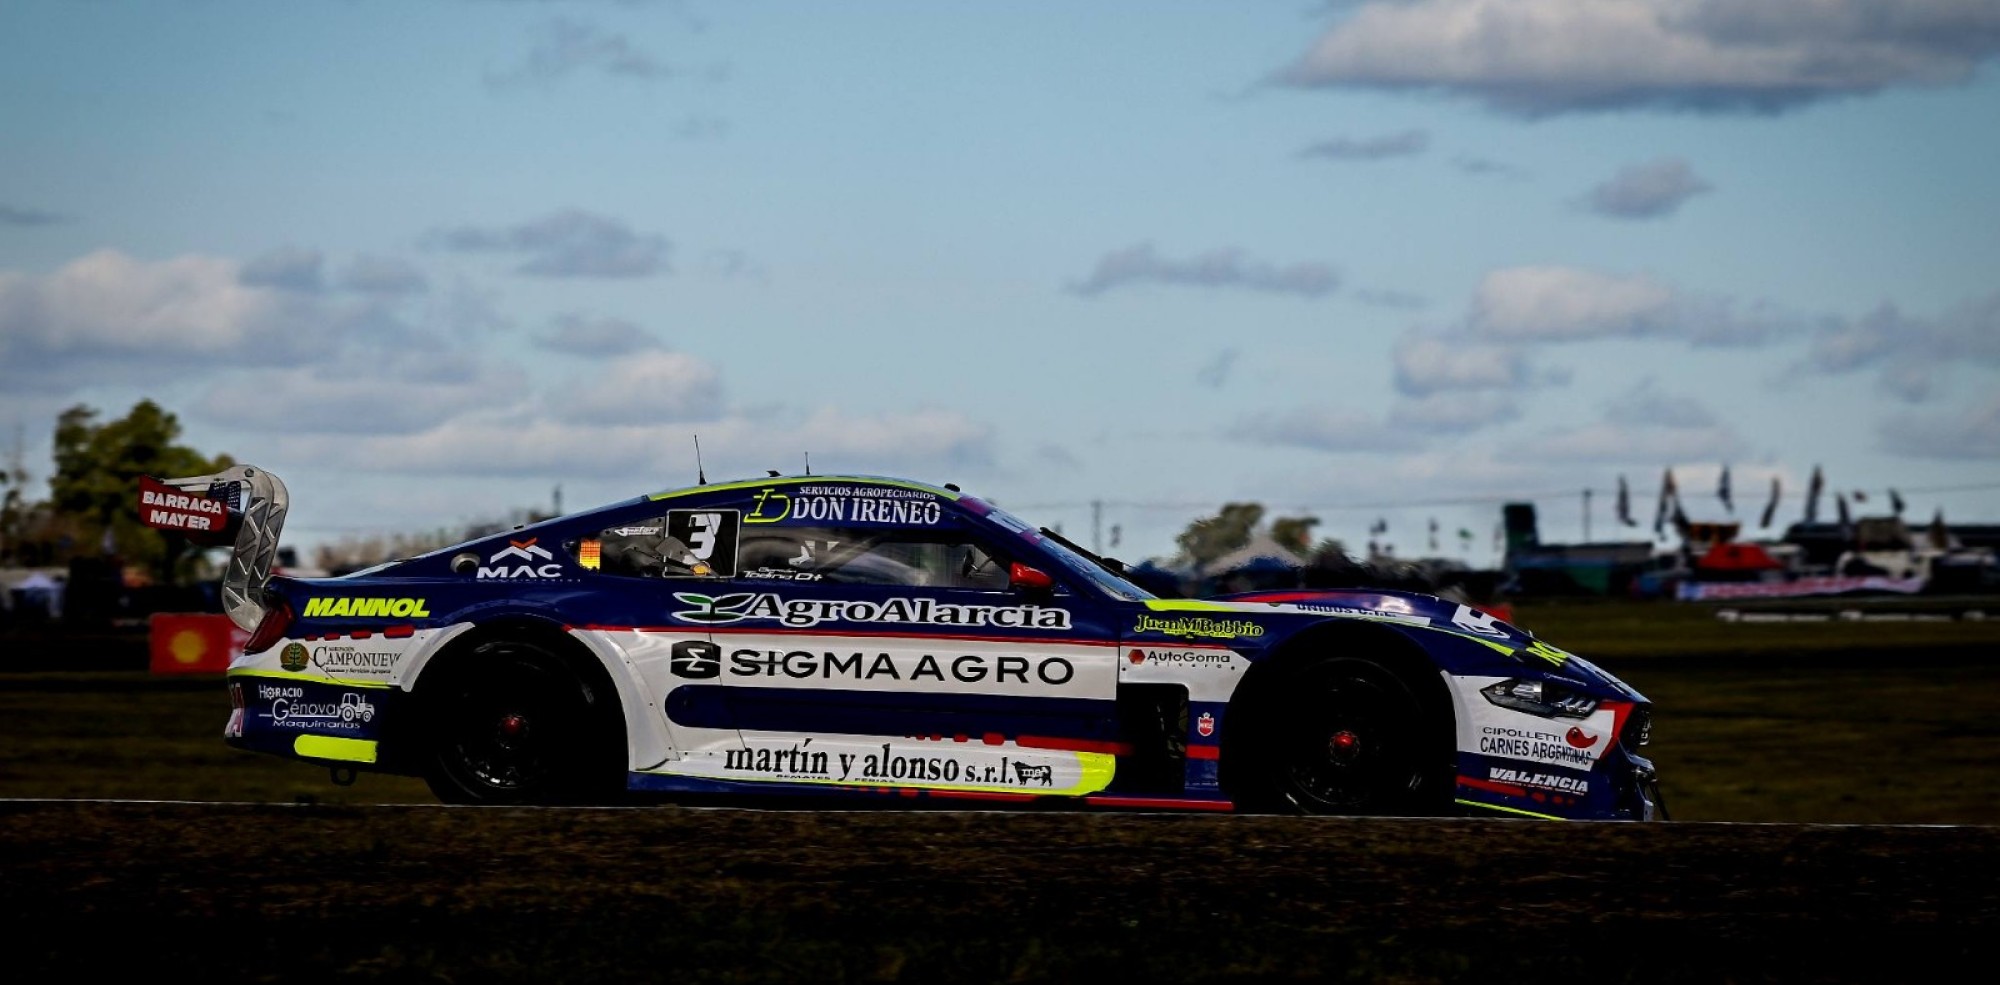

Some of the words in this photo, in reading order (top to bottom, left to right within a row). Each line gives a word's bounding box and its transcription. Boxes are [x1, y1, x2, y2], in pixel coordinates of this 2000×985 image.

[142, 491, 222, 514] BARRACA
[800, 486, 851, 496] SERVICIOS
[853, 488, 936, 500] AGROPECUARIOS
[150, 510, 211, 530] MAYER
[792, 497, 845, 520] DON
[849, 498, 941, 525] IRENEO
[688, 513, 721, 560] 3
[476, 564, 563, 578] MAC
[303, 598, 430, 617] MANNOL
[745, 593, 1072, 629] AgroAlarcia
[1147, 651, 1230, 663] AutoGoma
[258, 685, 303, 699] HORACIO
[272, 698, 336, 720] Génova
[272, 720, 361, 729] Maquinarias
[1483, 726, 1561, 743] CIPOLLETTI
[724, 738, 829, 774] martín
[838, 752, 856, 781] y
[863, 744, 960, 782] alonso
[965, 757, 1014, 784] s.r.l.
[1480, 737, 1530, 757] CARNES
[1531, 742, 1591, 766] ARGENTINAS
[1489, 767, 1588, 793] VALENCIA
